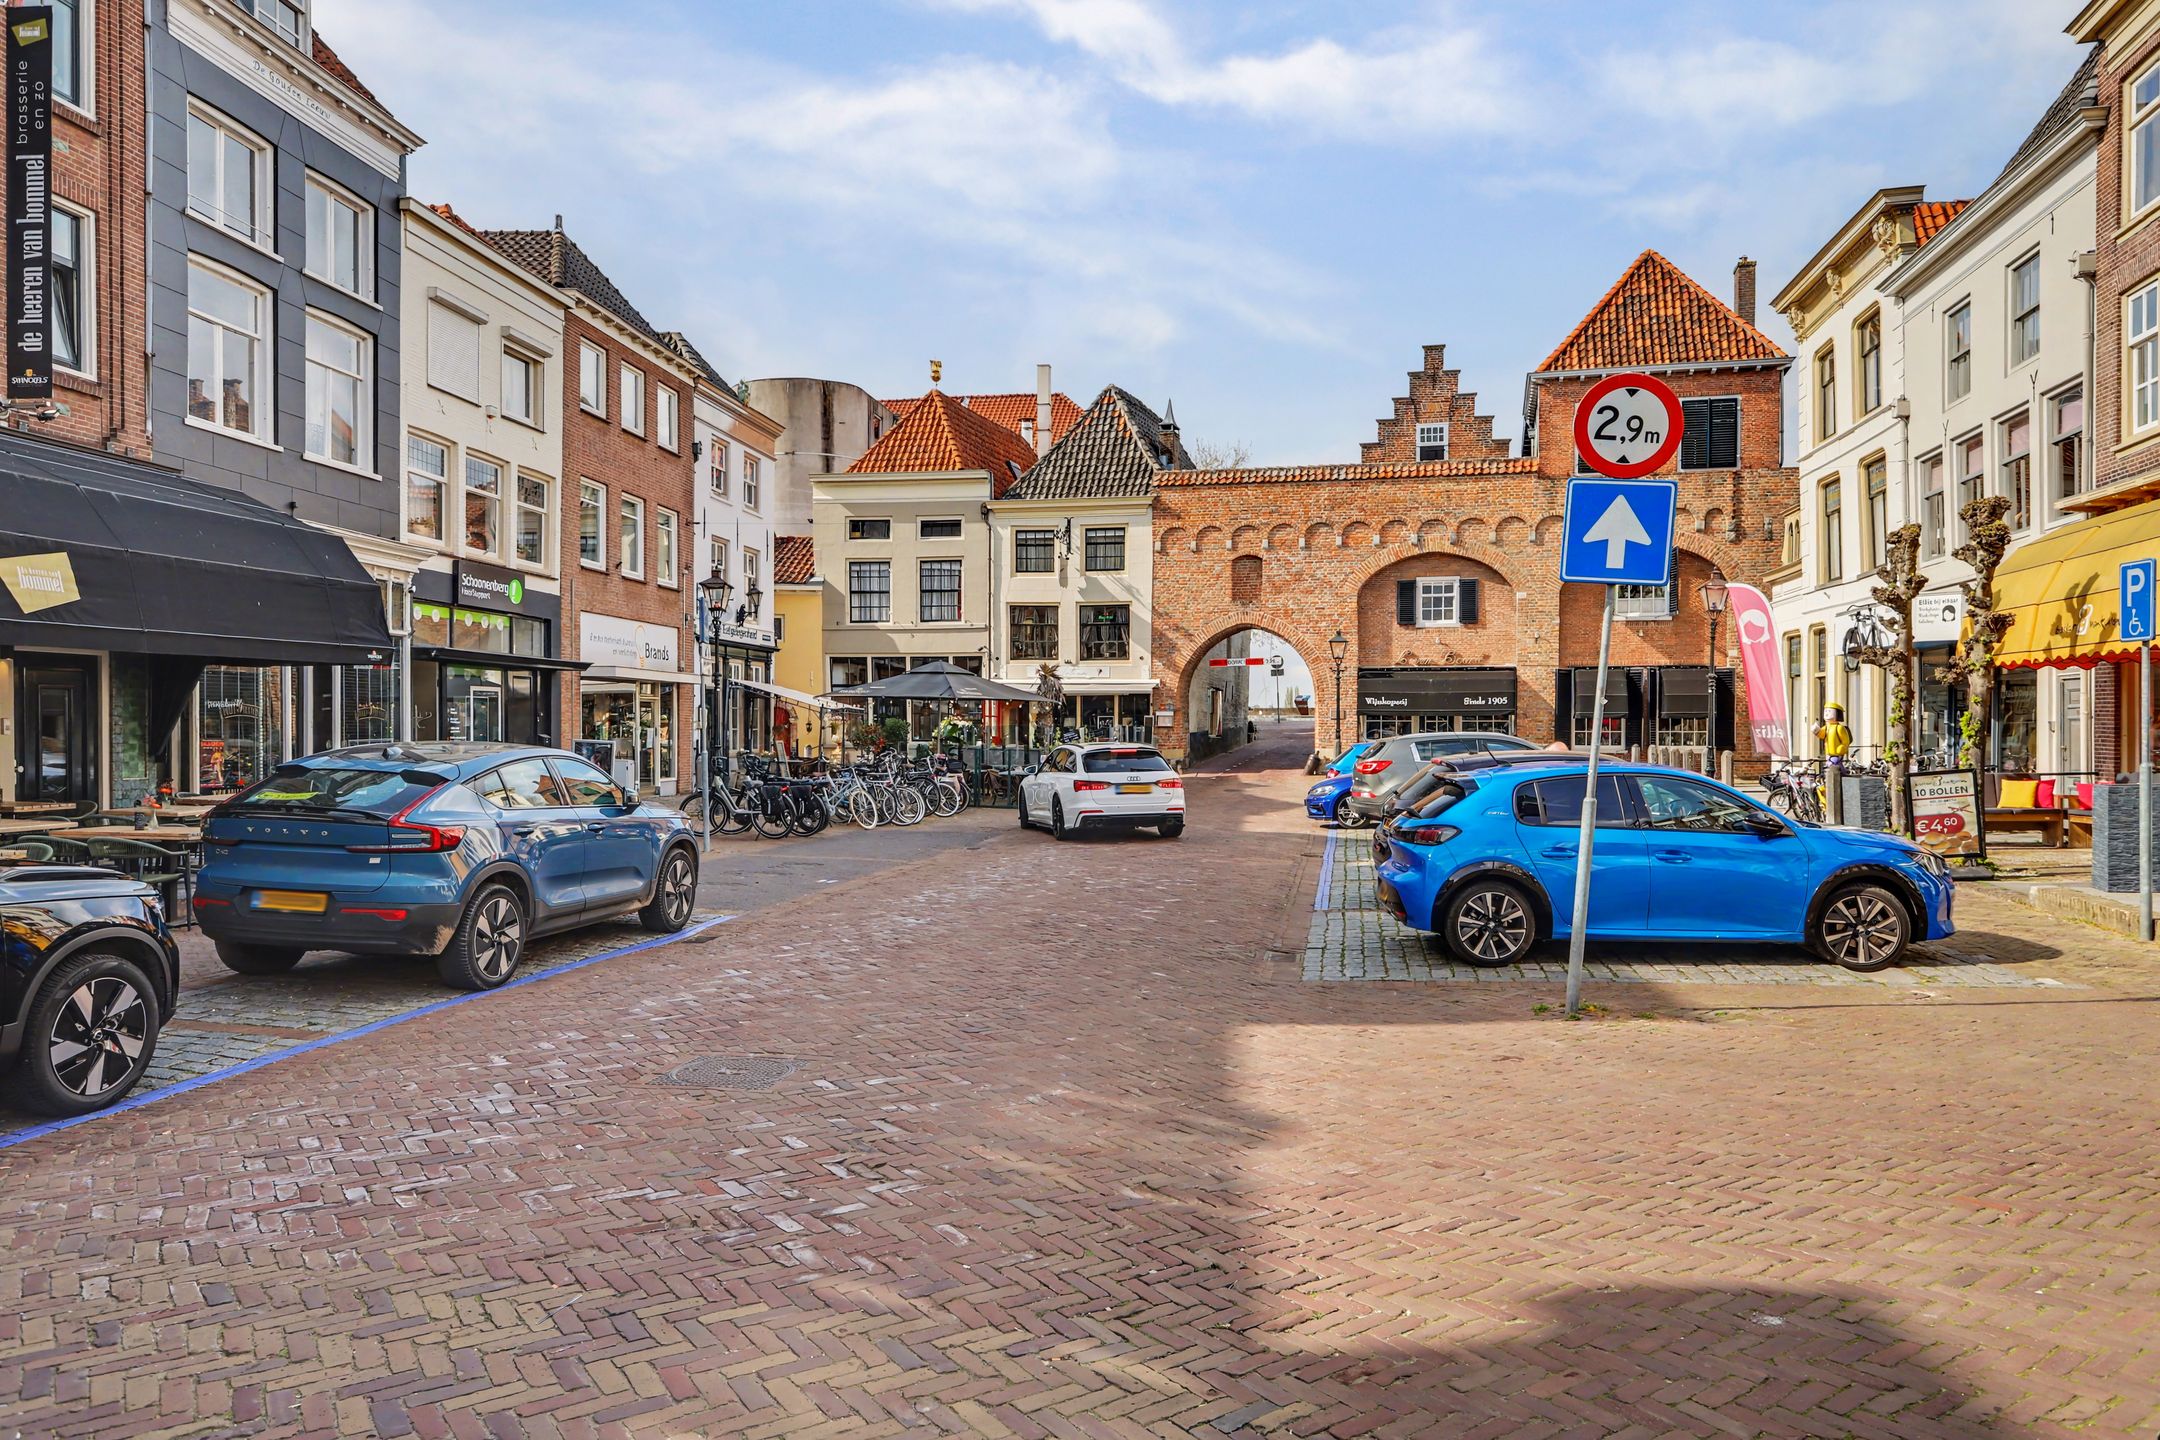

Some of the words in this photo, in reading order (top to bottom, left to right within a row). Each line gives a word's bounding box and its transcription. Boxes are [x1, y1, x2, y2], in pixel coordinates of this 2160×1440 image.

[15, 60, 28, 144] brasserie
[34, 108, 45, 130] en
[15, 154, 45, 224] bommel
[23, 229, 43, 260] van
[17, 266, 43, 324] heeren
[17, 331, 43, 352] de
[17, 566, 64, 592] bommel
[461, 573, 510, 597] Schoonenberg
[2126, 567, 2146, 607] P
[644, 642, 670, 661] Brands
[1487, 697, 1508, 705] 1905
[1915, 789, 1927, 797] 10
[1929, 786, 1969, 797] BOLLEN
[247, 826, 329, 837] VOLVO
